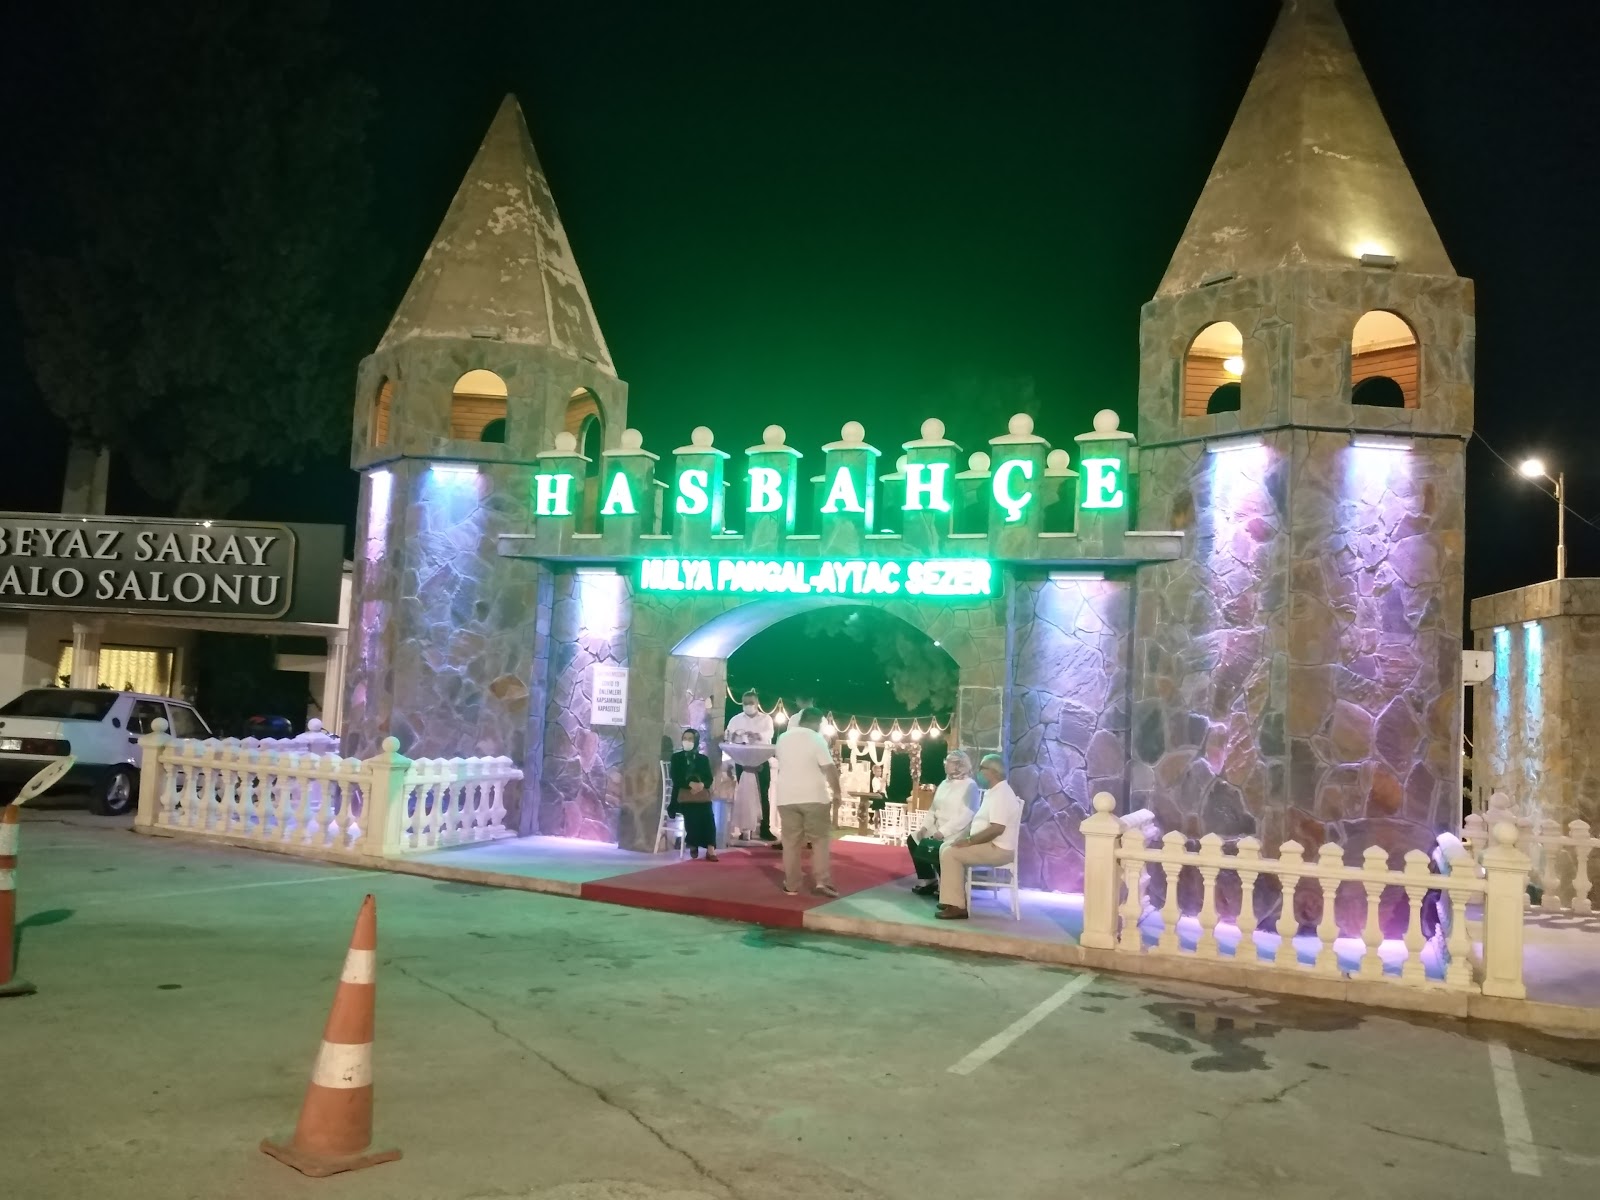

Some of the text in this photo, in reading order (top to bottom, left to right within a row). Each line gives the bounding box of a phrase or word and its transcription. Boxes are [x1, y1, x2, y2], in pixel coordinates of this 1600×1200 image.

[534, 457, 1124, 521] HASBAHÇE
[134, 531, 277, 567] SARAY
[96, 570, 281, 606] SALONU
[906, 559, 992, 596] SEZER
